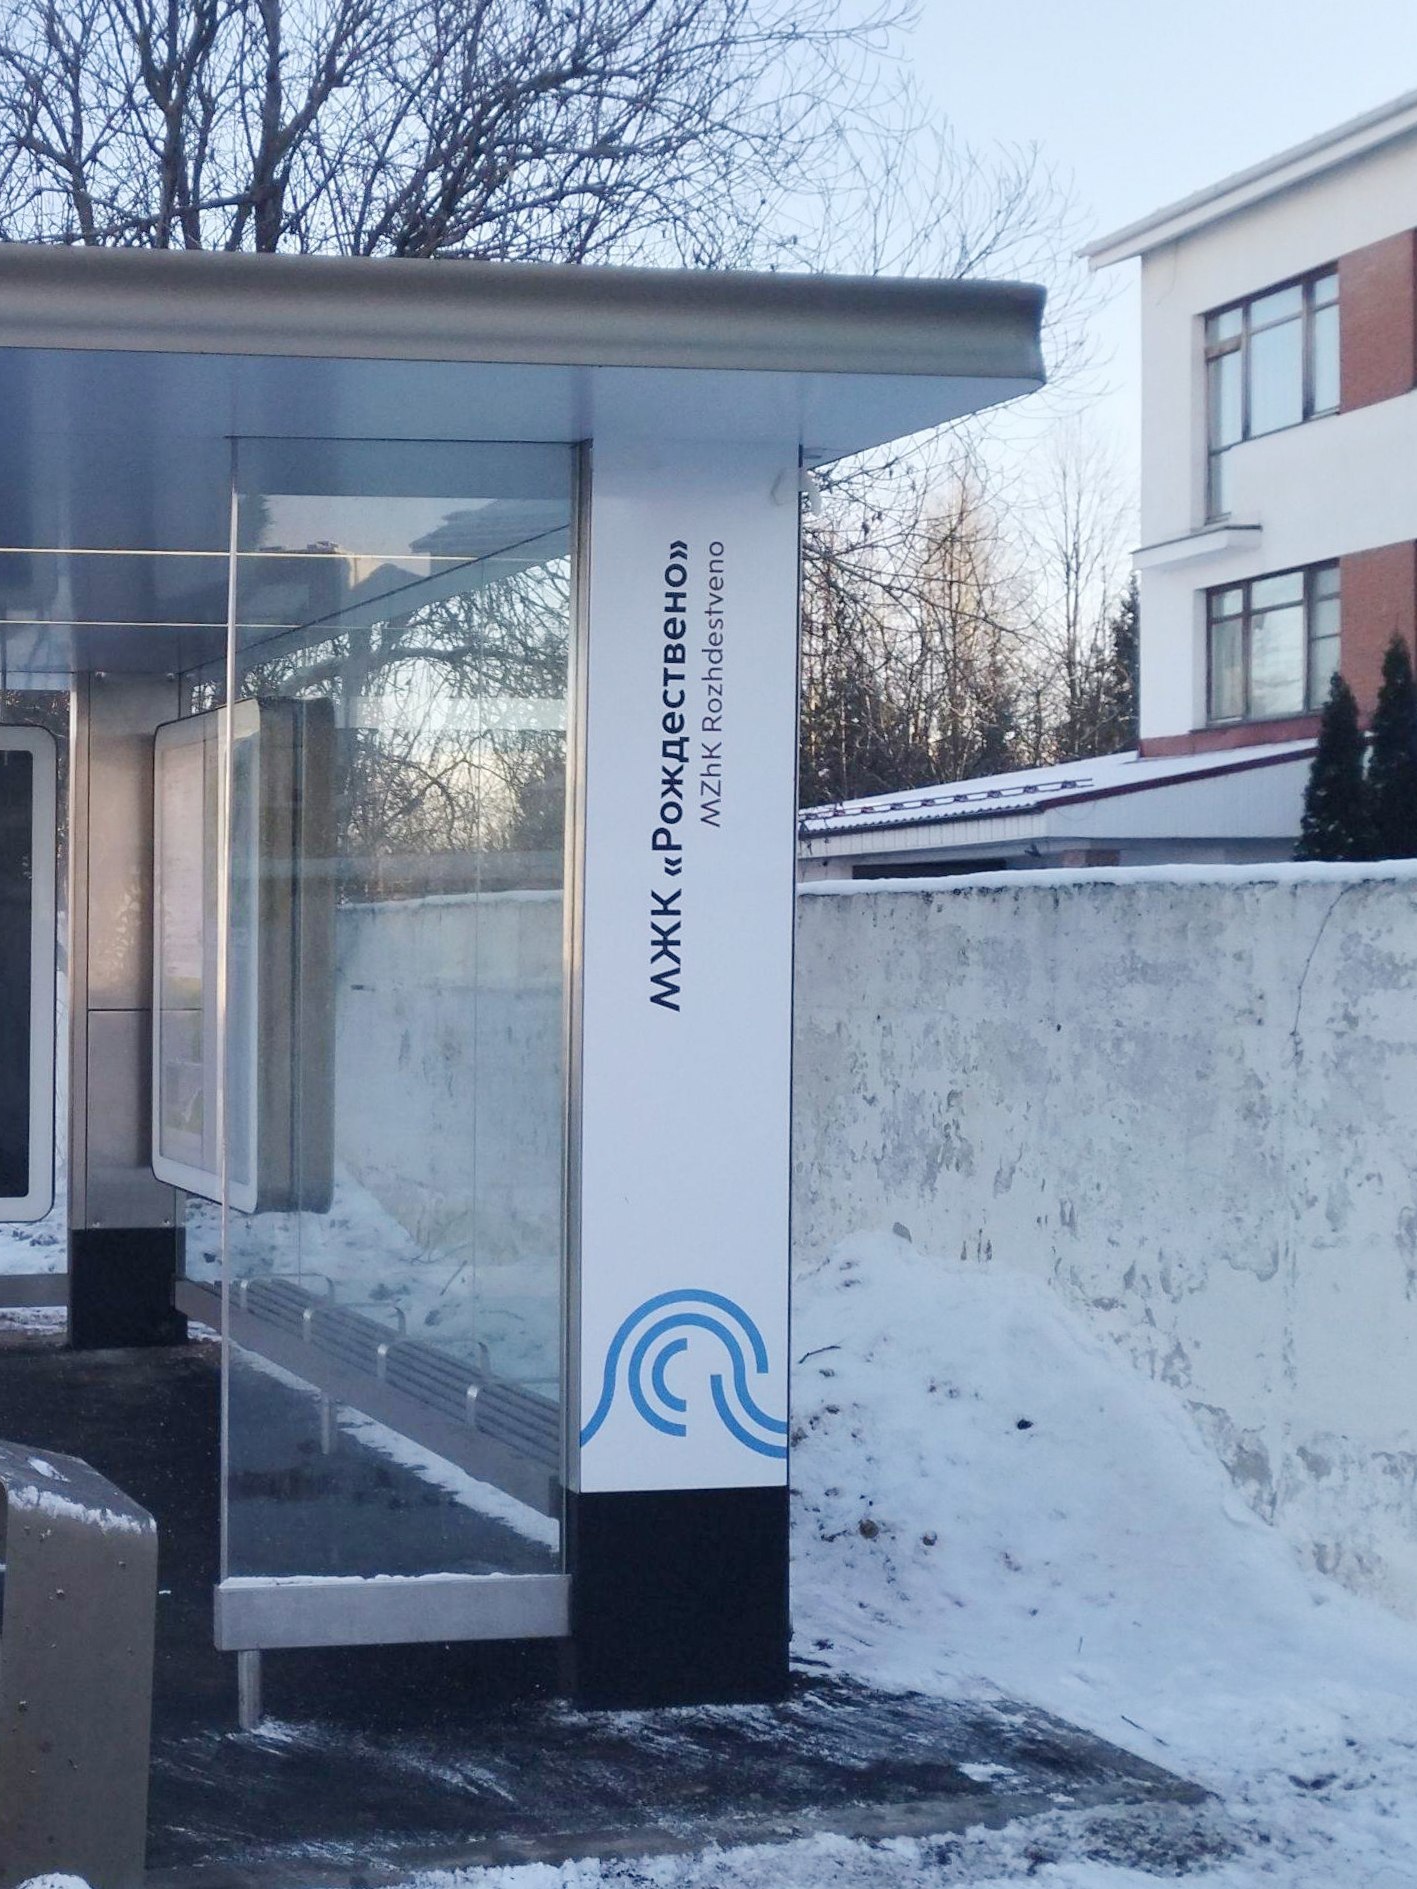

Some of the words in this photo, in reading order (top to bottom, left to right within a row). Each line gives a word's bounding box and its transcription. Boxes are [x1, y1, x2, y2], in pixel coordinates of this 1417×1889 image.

[651, 539, 690, 877] «Рождествено»
[701, 541, 725, 732] Rozhdestveno
[699, 741, 722, 828] MZhK
[649, 888, 682, 1013] МЖК
